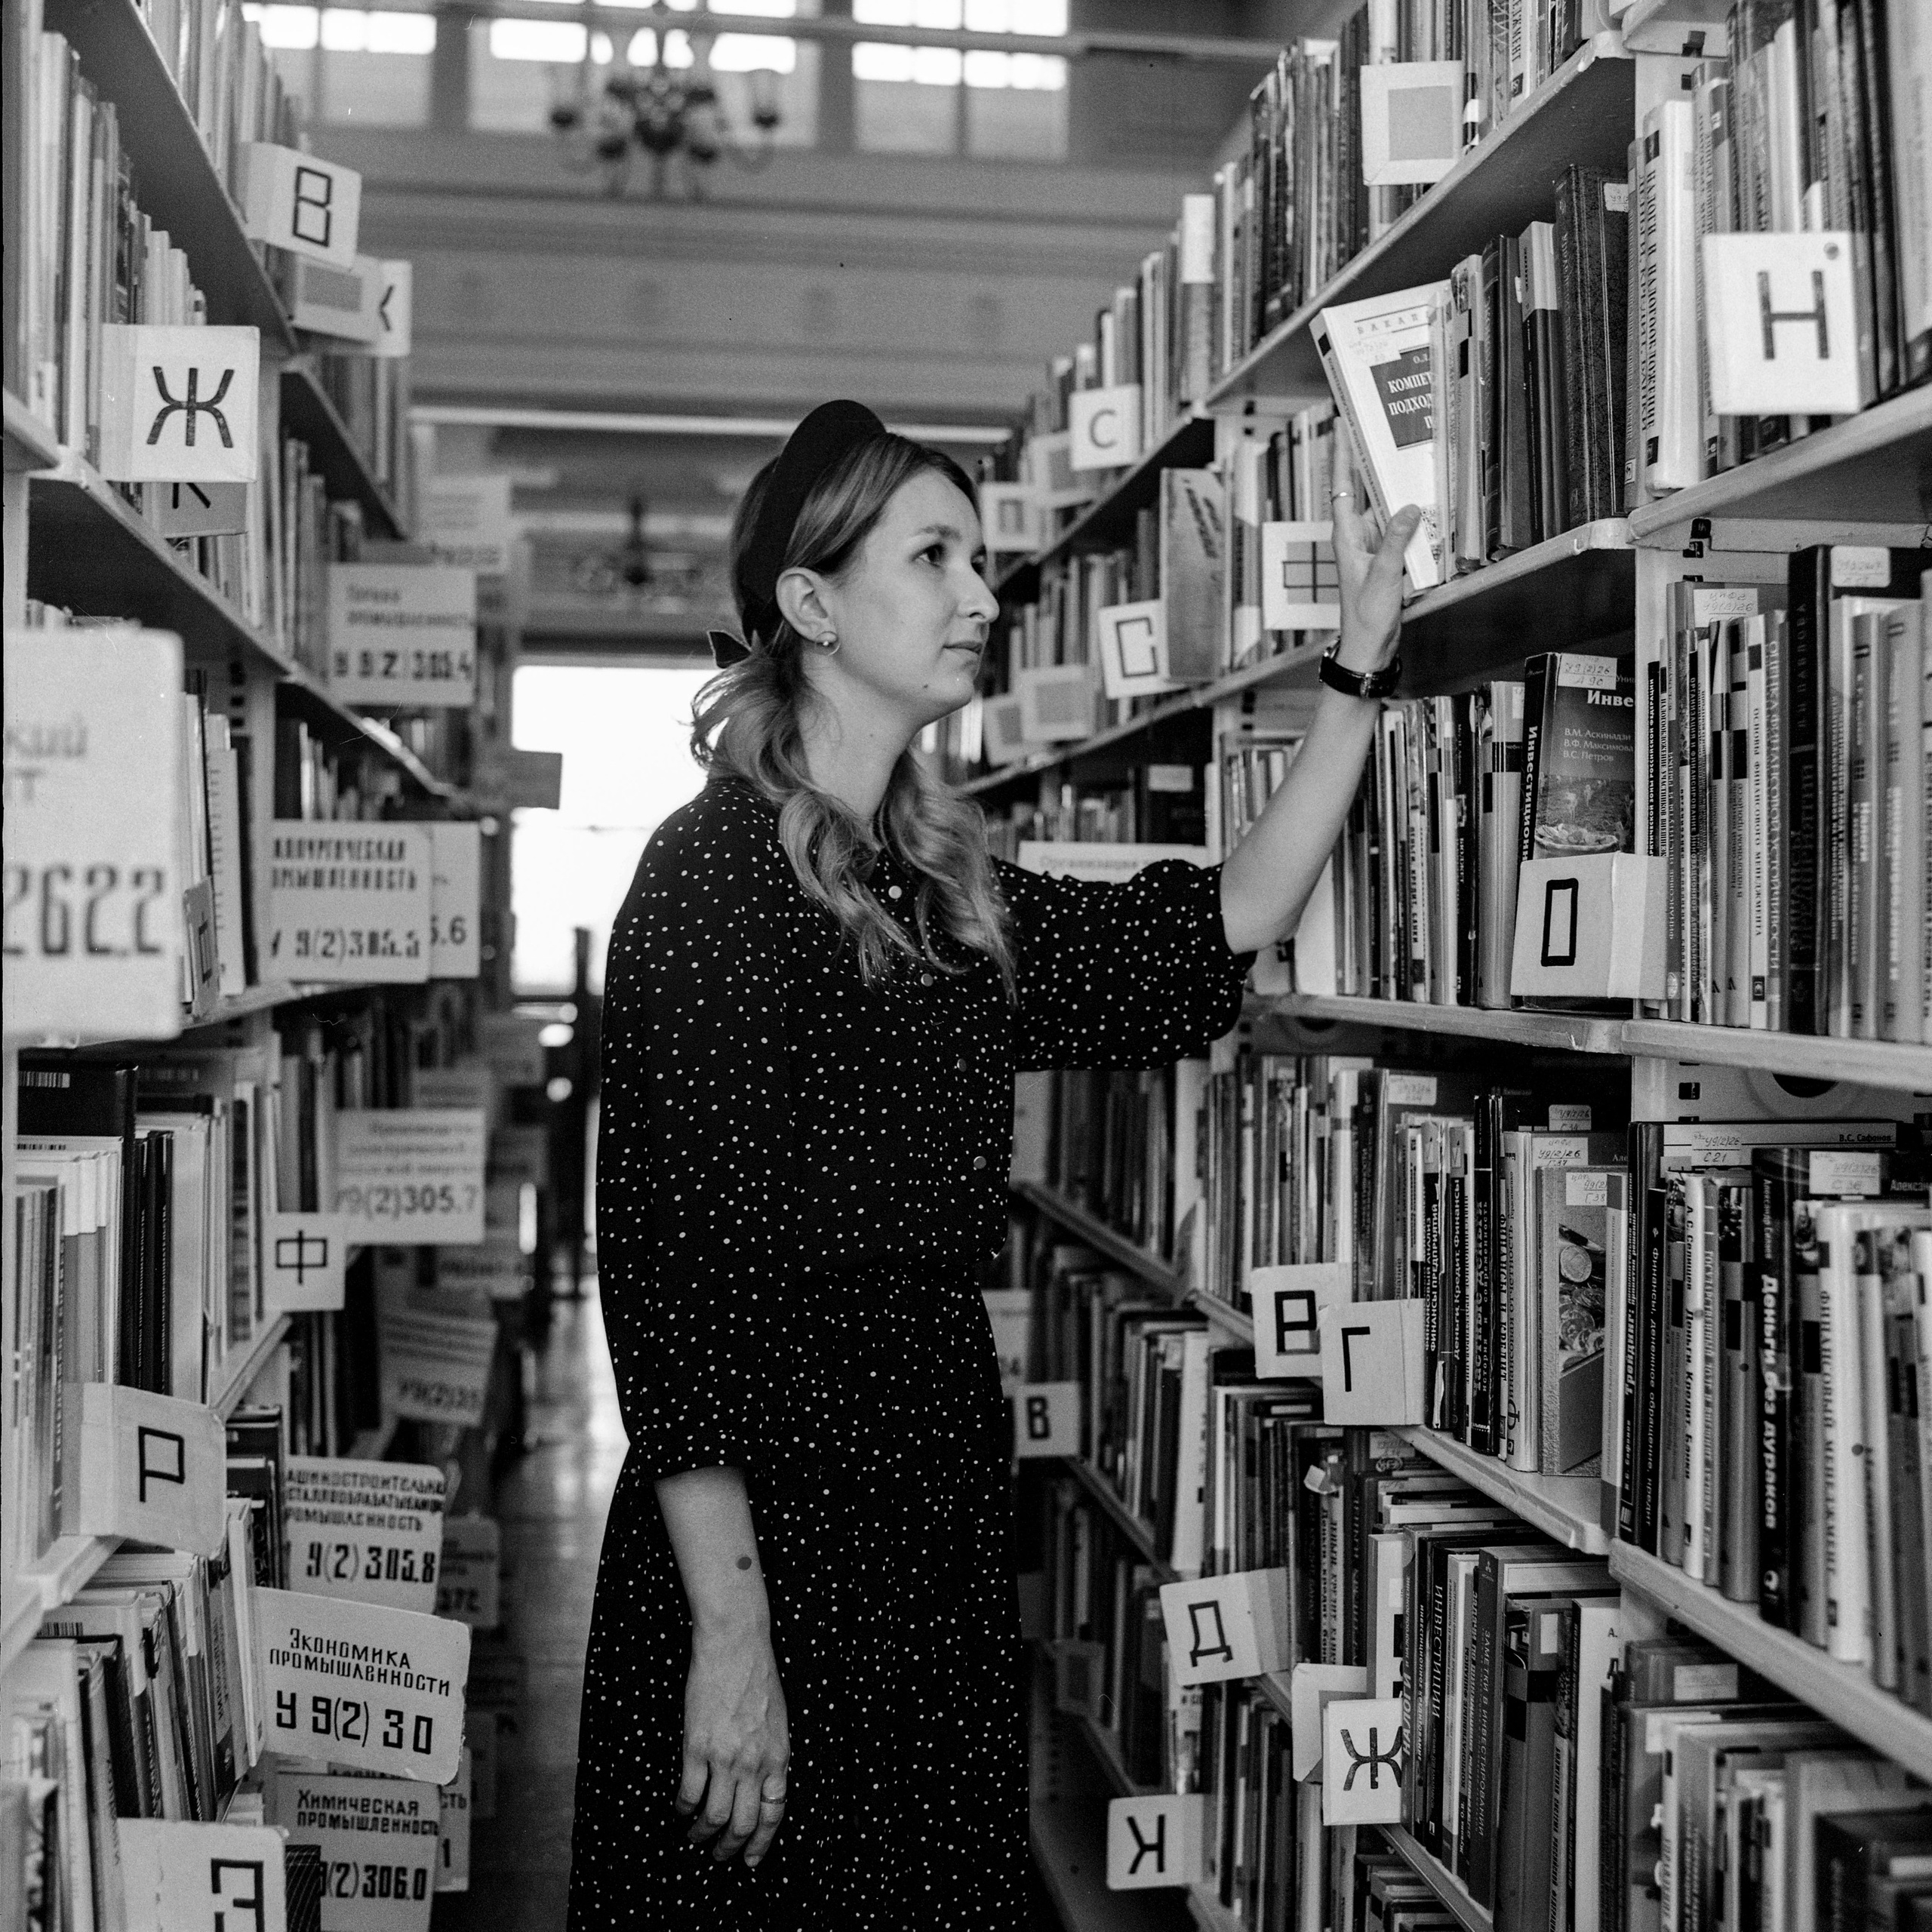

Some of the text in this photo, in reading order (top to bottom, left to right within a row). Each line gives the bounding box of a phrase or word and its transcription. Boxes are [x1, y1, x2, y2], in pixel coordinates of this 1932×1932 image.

[294, 167, 332, 247] В
[1647, 171, 1657, 429] НАЛОГИ И НАЛОГООБЛОЖЕНИЕ
[1757, 270, 1829, 360] Н
[146, 366, 235, 448] Ж
[1090, 410, 1118, 448] С
[1587, 690, 1634, 707] Инве
[1839, 1134, 1891, 1143] В.С. Сафонов
[276, 1230, 328, 1285] Ф
[1430, 1204, 1439, 1288] ПРЕДПРИЯТИЙ
[1685, 1234, 1694, 1291] Селищев
[1500, 1303, 1507, 1312] И
[1506, 1225, 1520, 1431] Финансовая отчетность
[1342, 1326, 1371, 1392] Г
[1500, 1321, 1508, 1381] КРЕДИТ
[1647, 1392, 1657, 1472] обращение,
[1761, 1274, 1780, 1529] Деньги без дураков
[138, 1426, 185, 1503] Р
[1684, 1433, 1693, 1479] Банки
[290, 1628, 411, 1669] ЭКОНОМИКА
[1188, 1601, 1233, 1667] Д
[1432, 1584, 1443, 1718] ИНВЕСТИЦИИ
[270, 1648, 450, 1697] ПРОМЫШЛЕННОСТИ
[1402, 1672, 1411, 1756] НАЛОГИ
[1340, 1727, 1401, 1791] Ж
[1478, 1709, 1489, 1836] ИНВЕСТИРОВАНИИ
[297, 1789, 420, 1817] ХИМИЧЕСКАЯ
